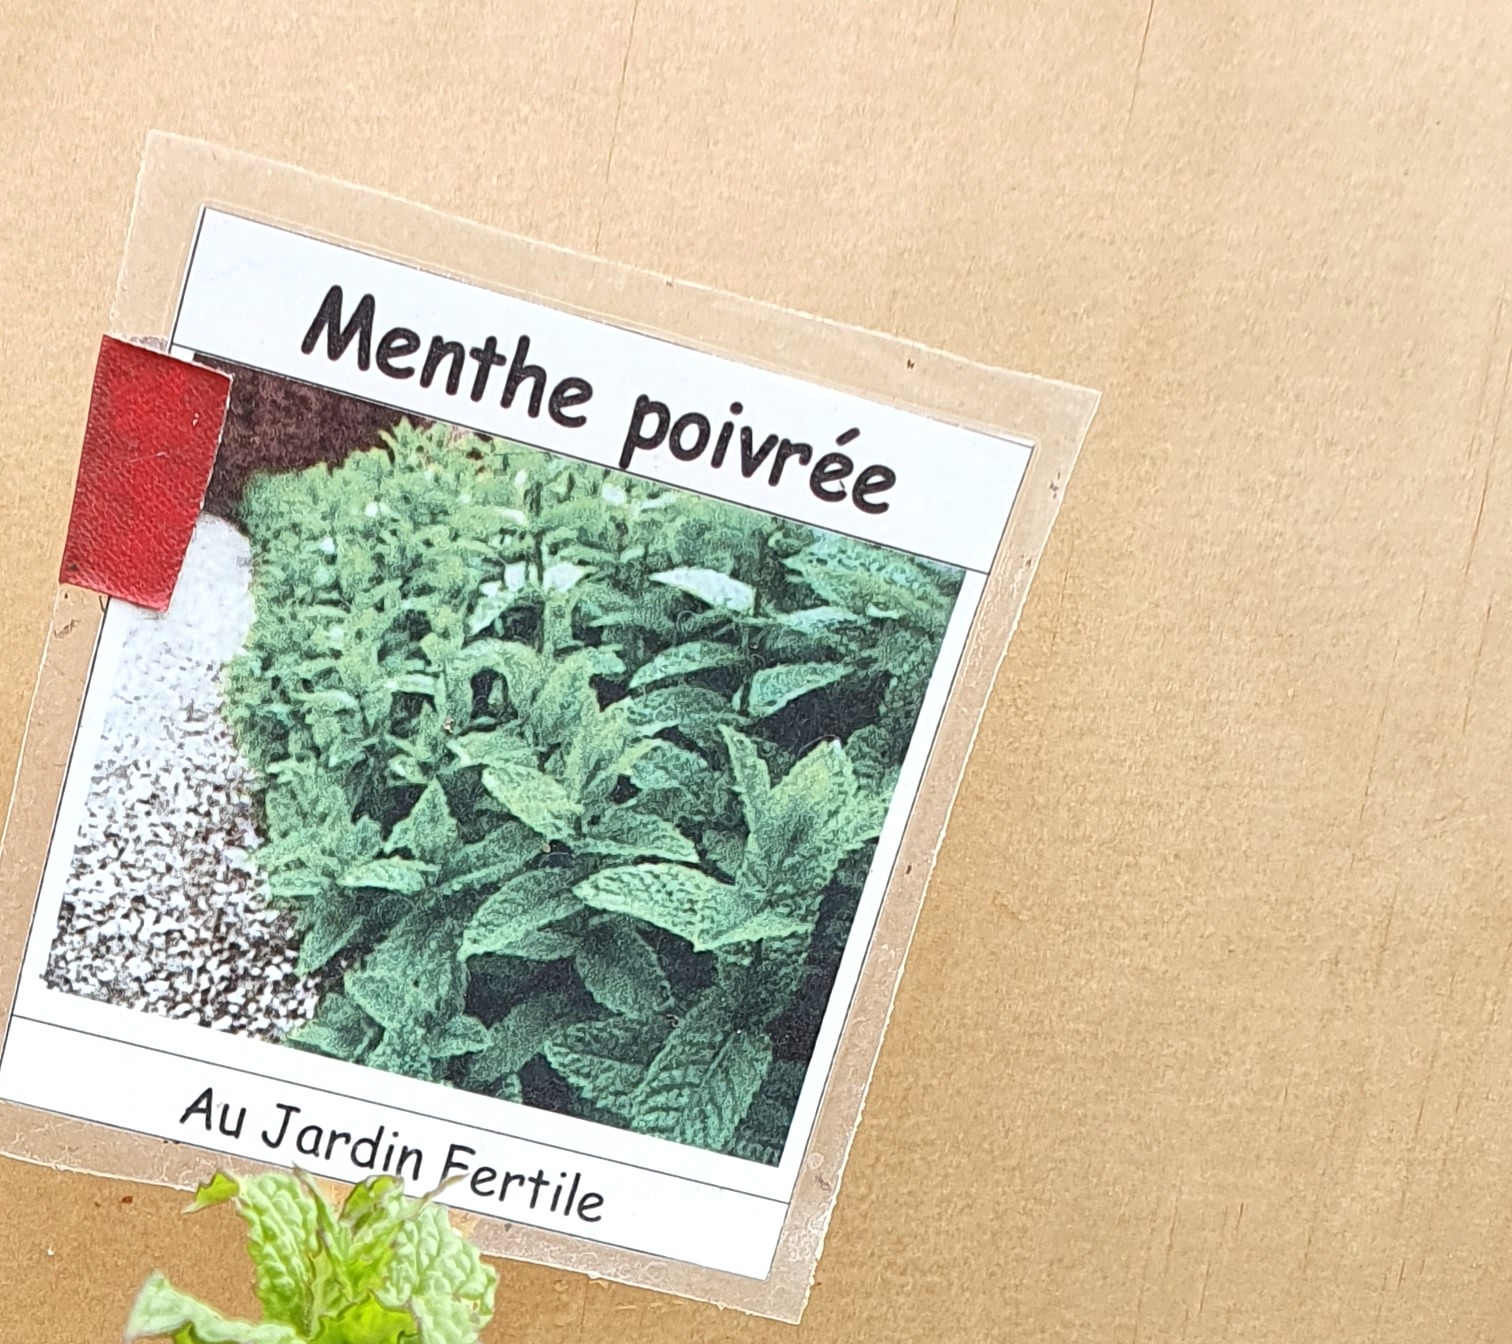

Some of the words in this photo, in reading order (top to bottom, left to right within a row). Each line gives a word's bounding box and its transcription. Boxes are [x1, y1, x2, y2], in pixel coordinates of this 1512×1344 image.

[300, 284, 593, 428] Menthe
[619, 394, 897, 514] poivrée
[179, 1086, 247, 1139] Au
[261, 1102, 423, 1181] Jardin
[440, 1143, 605, 1222] Fertile
